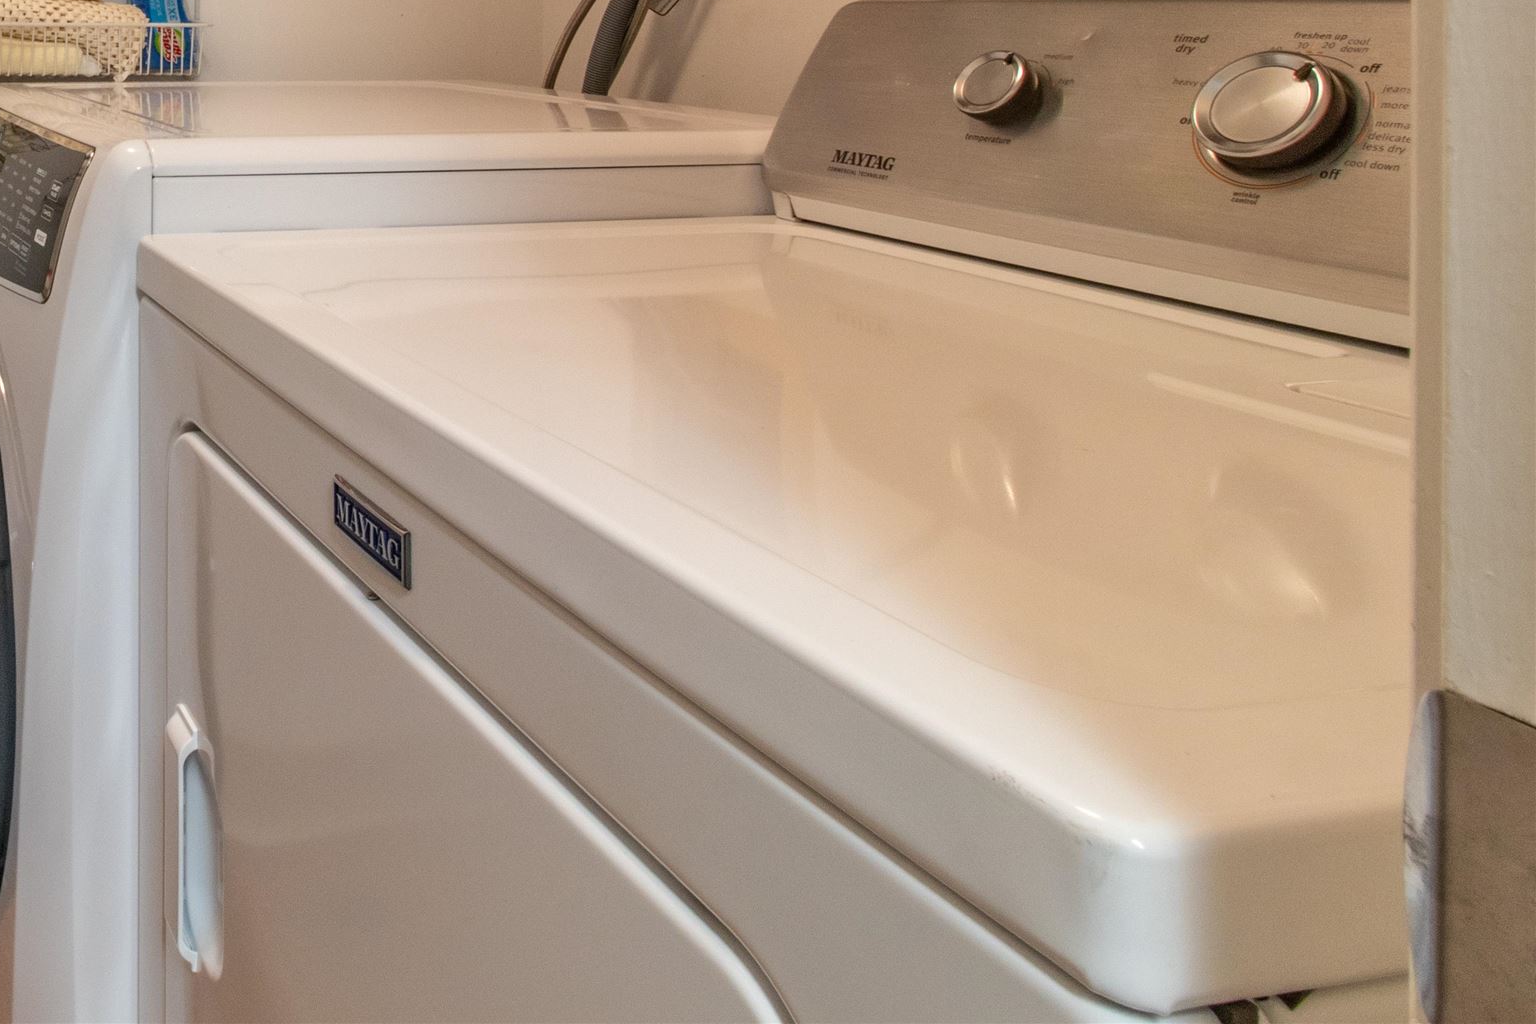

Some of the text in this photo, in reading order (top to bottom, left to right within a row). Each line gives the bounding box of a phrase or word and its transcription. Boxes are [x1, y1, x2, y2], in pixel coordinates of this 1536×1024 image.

[1173, 33, 1209, 45] timed
[1293, 31, 1348, 42] freshen up
[1347, 37, 1371, 47] cool
[1175, 43, 1196, 56] dry
[1321, 41, 1336, 50] 20
[1339, 45, 1369, 54] down
[1359, 62, 1383, 75] off
[1171, 77, 1198, 88] heavy
[964, 132, 1012, 145] temperature
[1360, 141, 1407, 155] less dry
[831, 149, 896, 172] MAYTAG
[1343, 158, 1401, 172] cool down
[1319, 167, 1343, 181] off
[1232, 190, 1261, 200] wrinkle
[1230, 197, 1259, 206] control
[335, 492, 400, 570] MAYTAG
